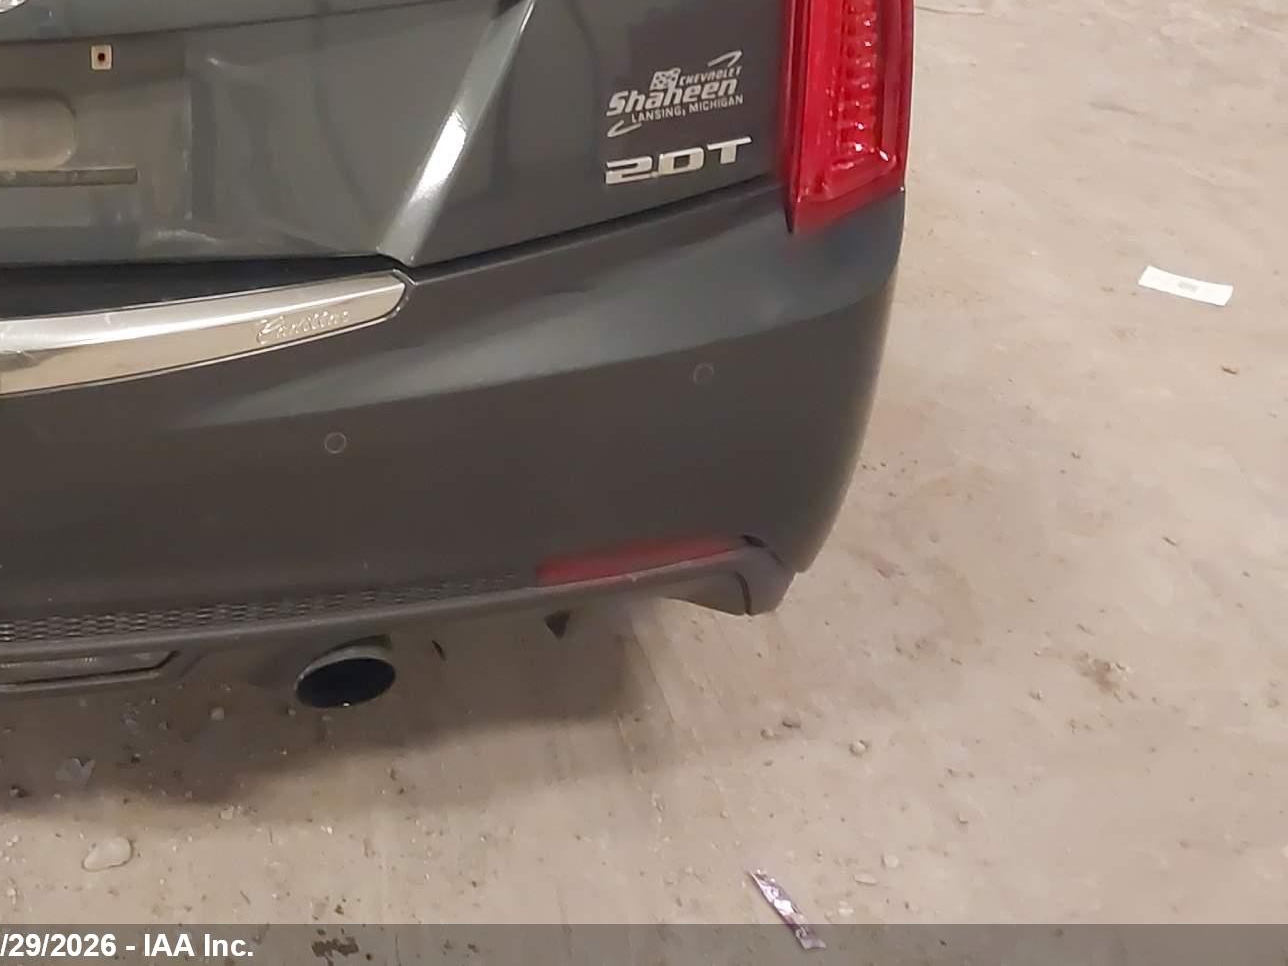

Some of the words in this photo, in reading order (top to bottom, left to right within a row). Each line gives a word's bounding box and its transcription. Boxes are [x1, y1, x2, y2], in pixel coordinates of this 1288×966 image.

[679, 66, 743, 86] CHEVROLET
[606, 78, 738, 116] Shaheen
[631, 105, 686, 123] LANSING,
[688, 94, 744, 114] MICHIGAN
